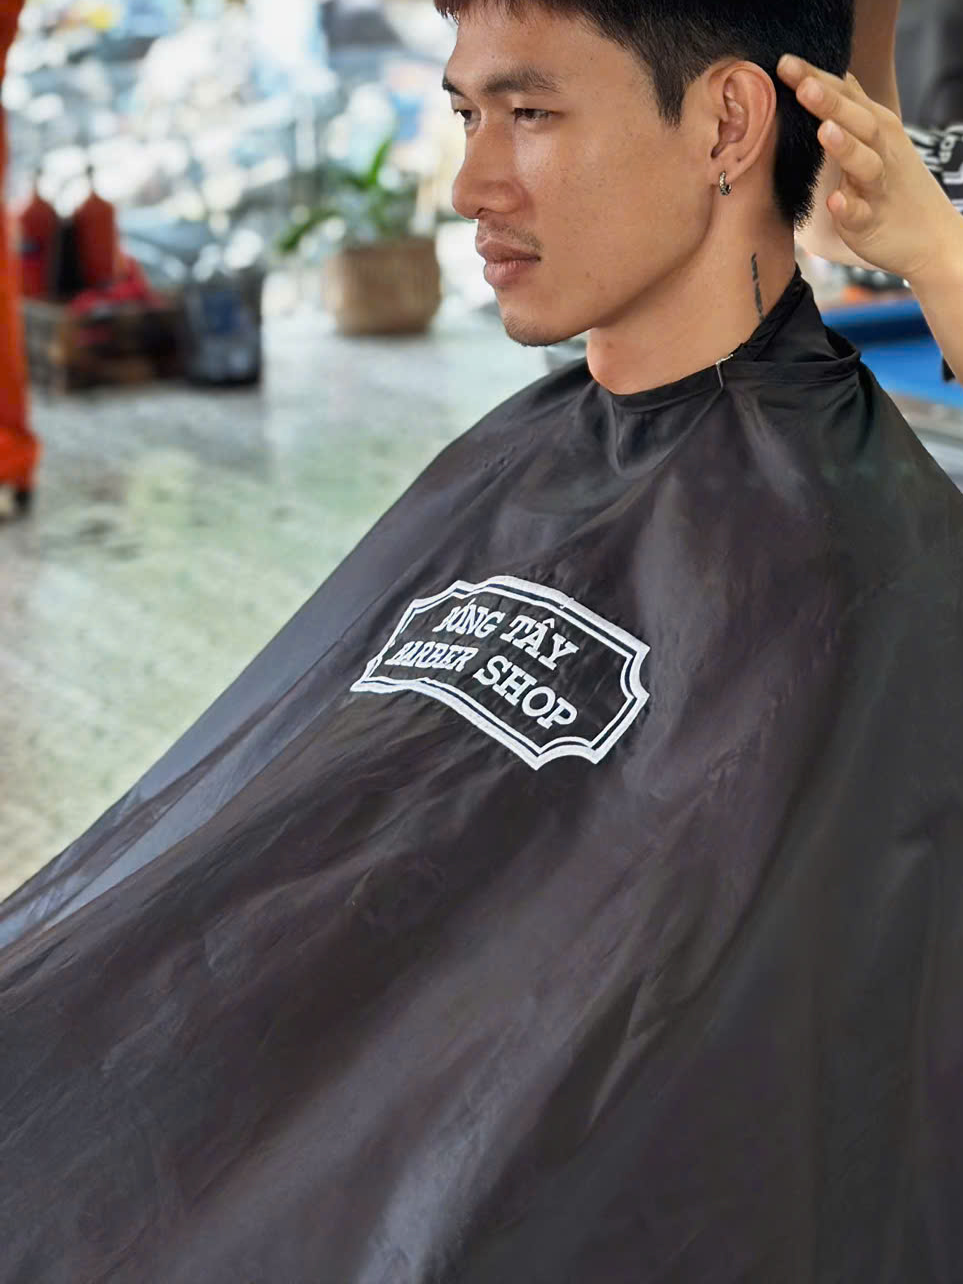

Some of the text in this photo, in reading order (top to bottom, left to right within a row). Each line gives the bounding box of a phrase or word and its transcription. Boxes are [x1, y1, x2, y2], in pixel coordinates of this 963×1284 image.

[500, 615, 580, 671] TÂY
[384, 641, 577, 729] BARBER SHOP
